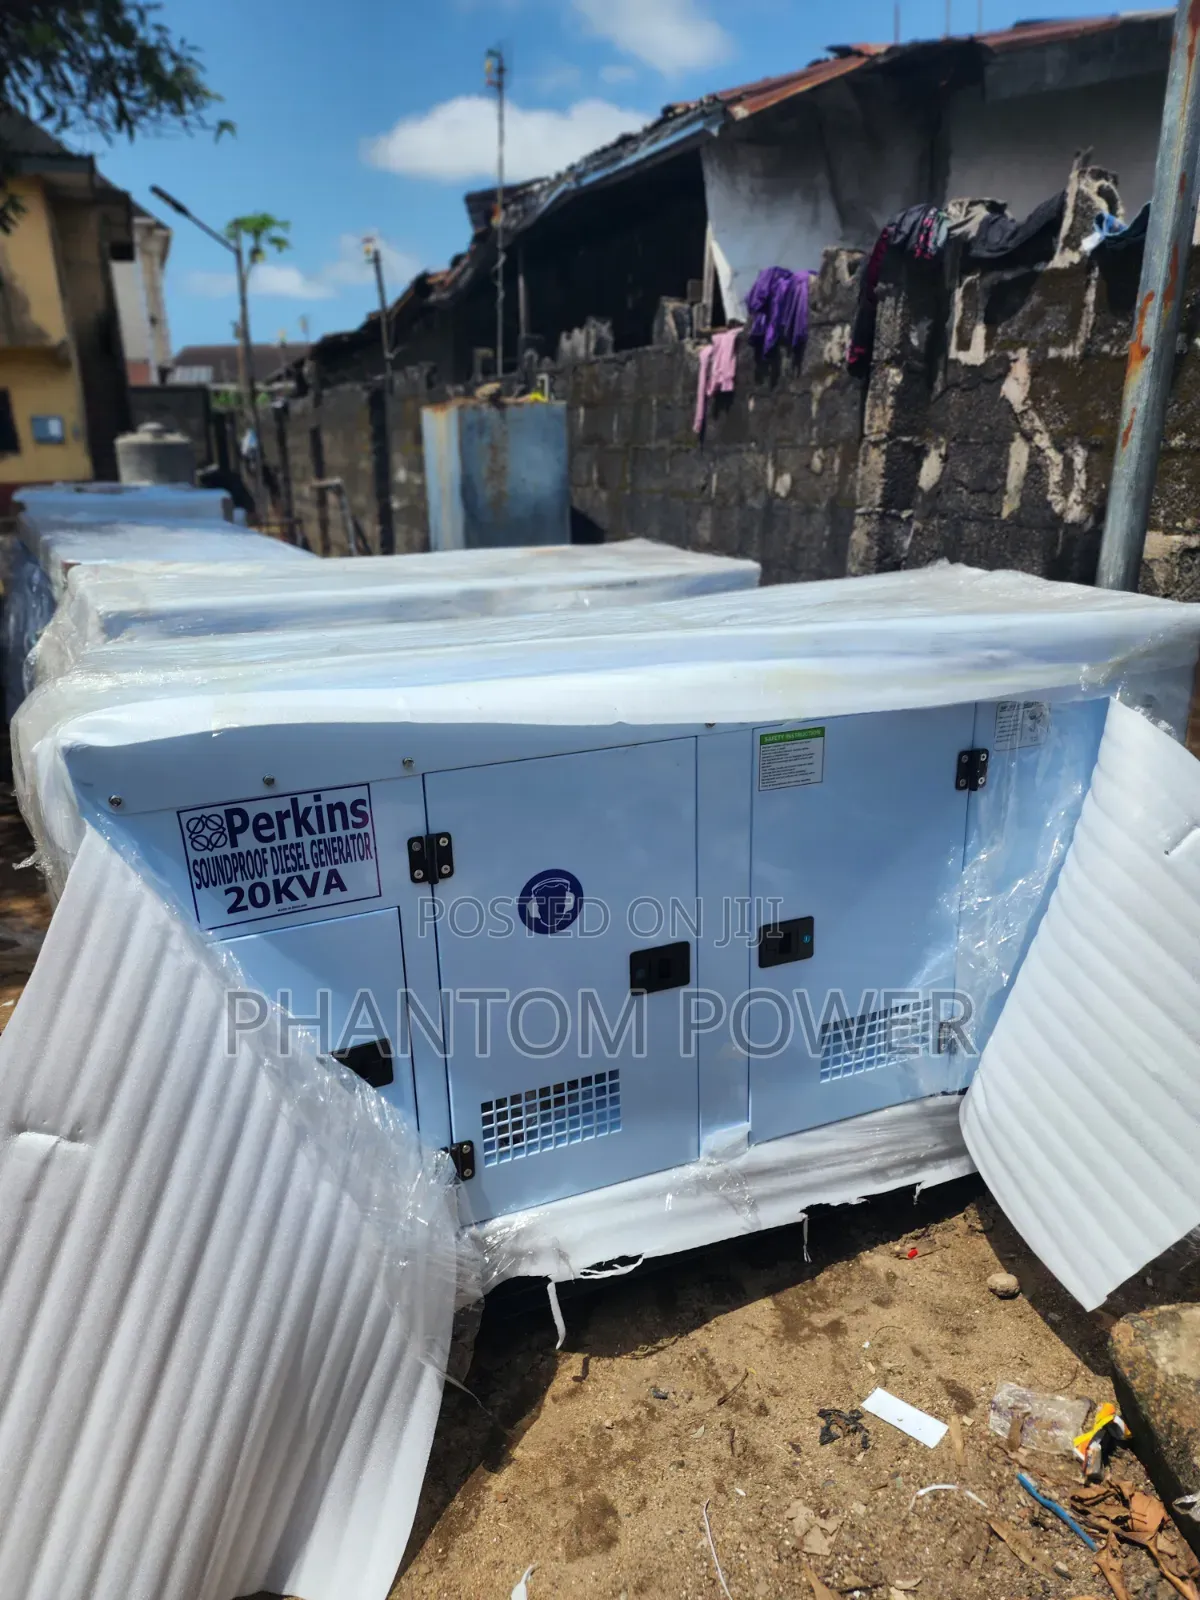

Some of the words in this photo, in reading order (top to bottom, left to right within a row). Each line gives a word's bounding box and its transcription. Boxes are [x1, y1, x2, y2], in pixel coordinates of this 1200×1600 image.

[764, 733, 785, 742] SAFETY
[224, 794, 369, 848] Perkins
[192, 847, 269, 890] SOUNDPROOF
[269, 842, 310, 876] DIESEL
[310, 832, 373, 869] GENERATOR
[224, 868, 347, 914] 20KVA
